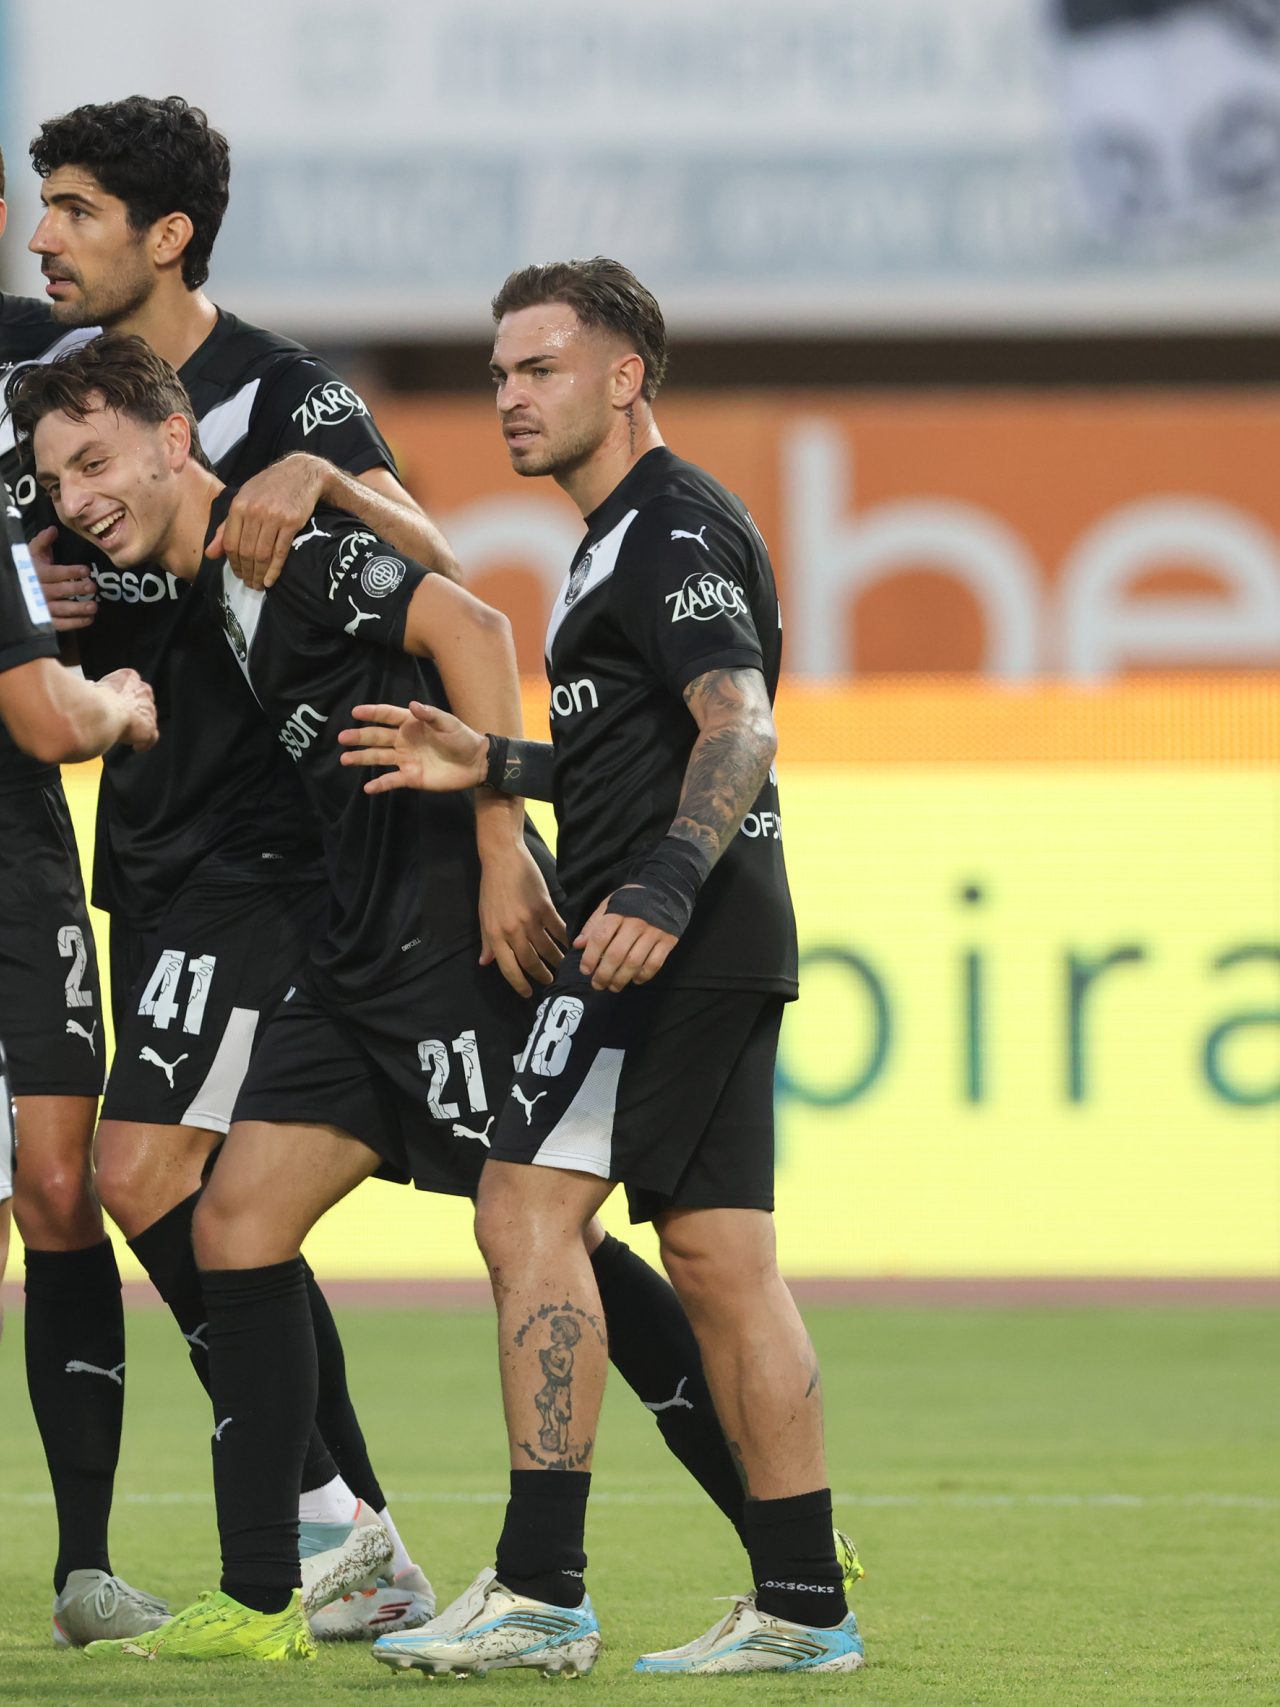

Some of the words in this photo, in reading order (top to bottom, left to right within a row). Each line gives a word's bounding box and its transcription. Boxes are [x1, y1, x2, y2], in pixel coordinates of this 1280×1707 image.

[57, 925, 93, 1008] 2
[137, 949, 217, 1035] 41
[417, 1029, 489, 1119] 21
[760, 1580, 835, 1594] OXSOCKS
